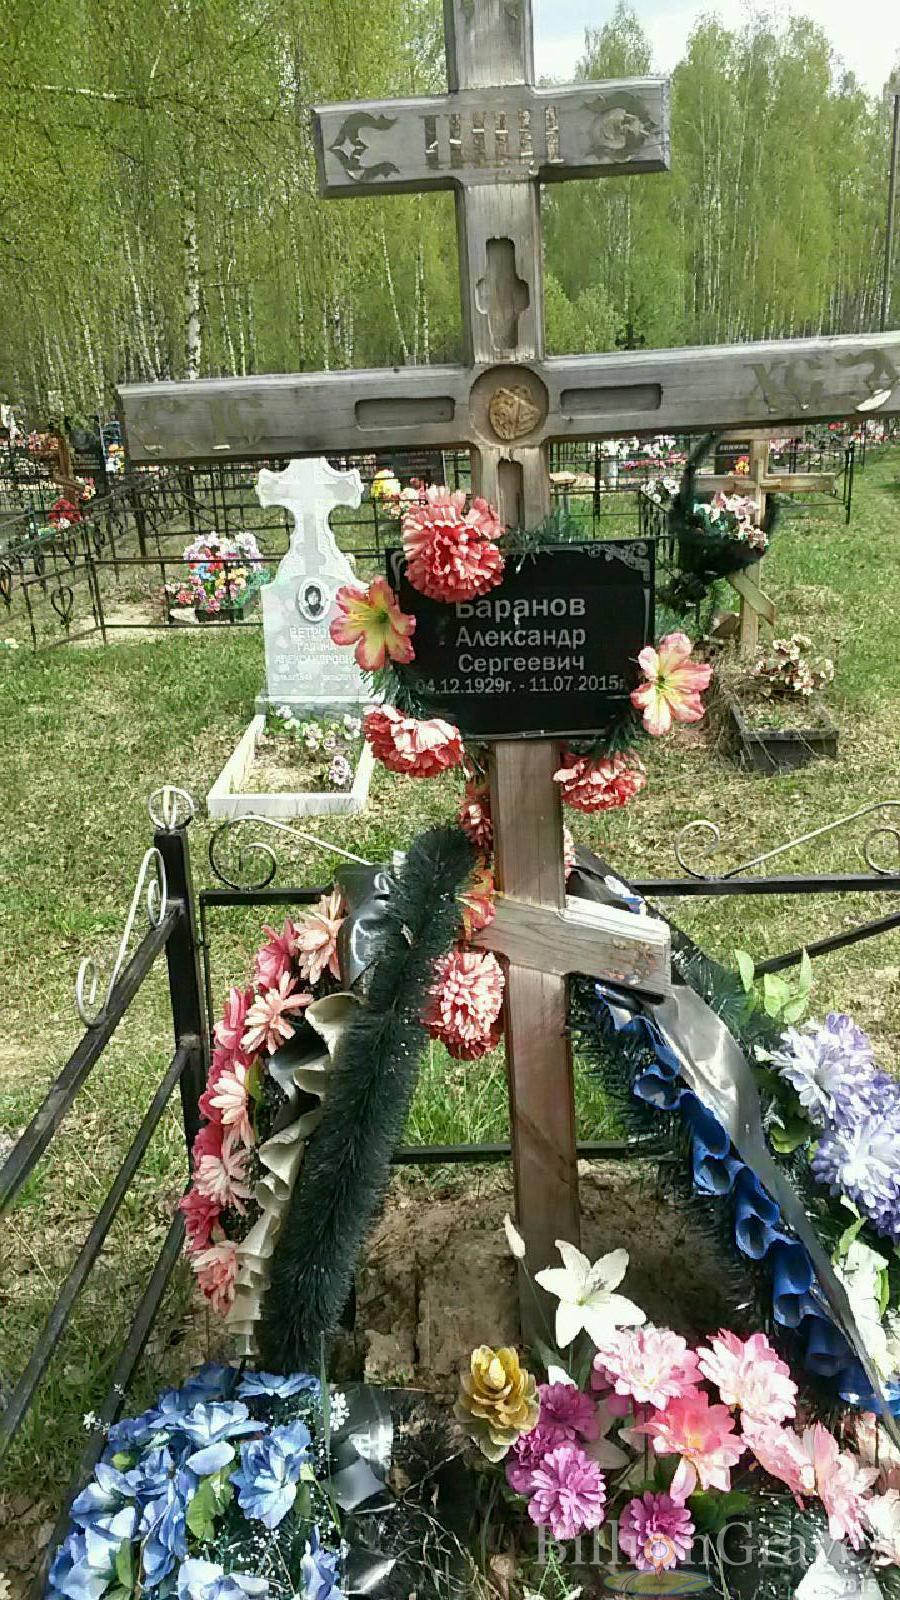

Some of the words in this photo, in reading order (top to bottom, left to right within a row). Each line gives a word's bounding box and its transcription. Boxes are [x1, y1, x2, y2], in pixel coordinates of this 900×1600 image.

[455, 598, 586, 623] Баранов
[289, 627, 328, 640] ВЕТРО
[455, 626, 586, 649] Александр
[458, 653, 585, 675] Сергеевич
